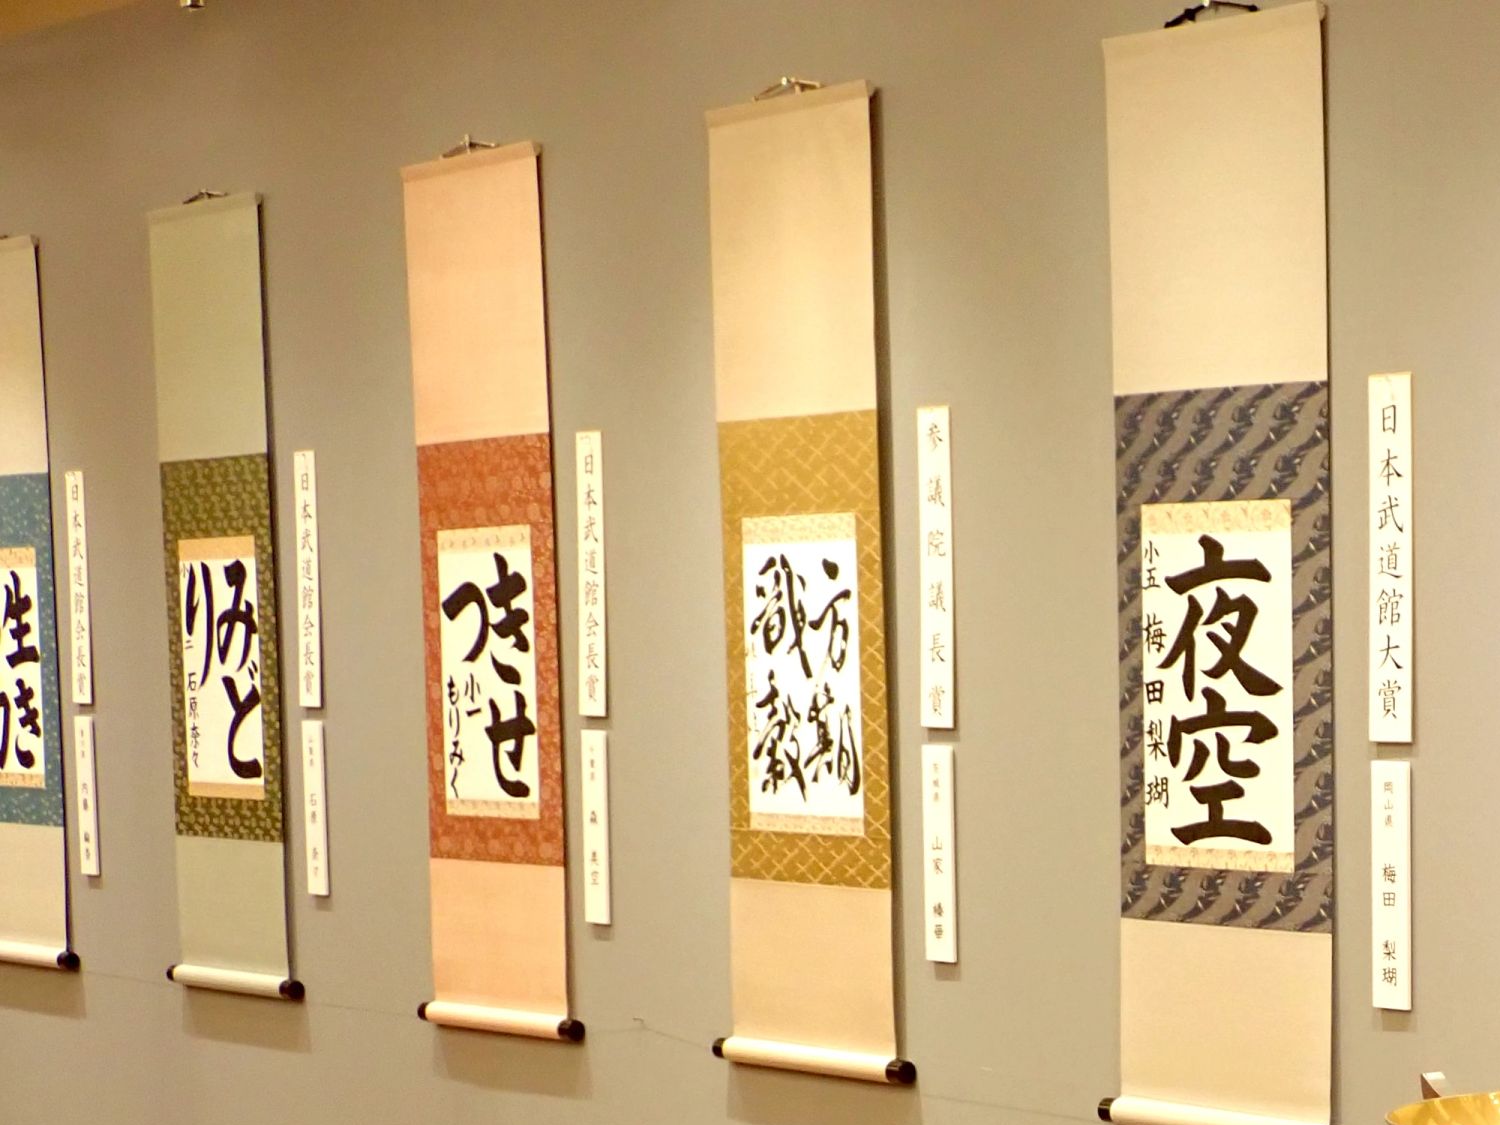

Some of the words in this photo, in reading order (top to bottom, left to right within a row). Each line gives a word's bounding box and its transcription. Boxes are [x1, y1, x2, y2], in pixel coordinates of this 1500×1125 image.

[3, 570, 41, 769] 生き
[185, 561, 214, 687] り
[216, 558, 263, 779] みど
[300, 473, 315, 694] 日本武道館会長賞
[441, 580, 490, 663] つ
[583, 455, 600, 702] 日本武道館会長賞
[927, 422, 946, 716] 参議院議長賞
[1143, 540, 1161, 590] 小五
[1377, 405, 1403, 719] 日本武道館大賞
[447, 675, 465, 799] もりみく
[464, 673, 482, 718] 小一
[485, 552, 537, 798] きせ
[1157, 535, 1284, 847] 夜空
